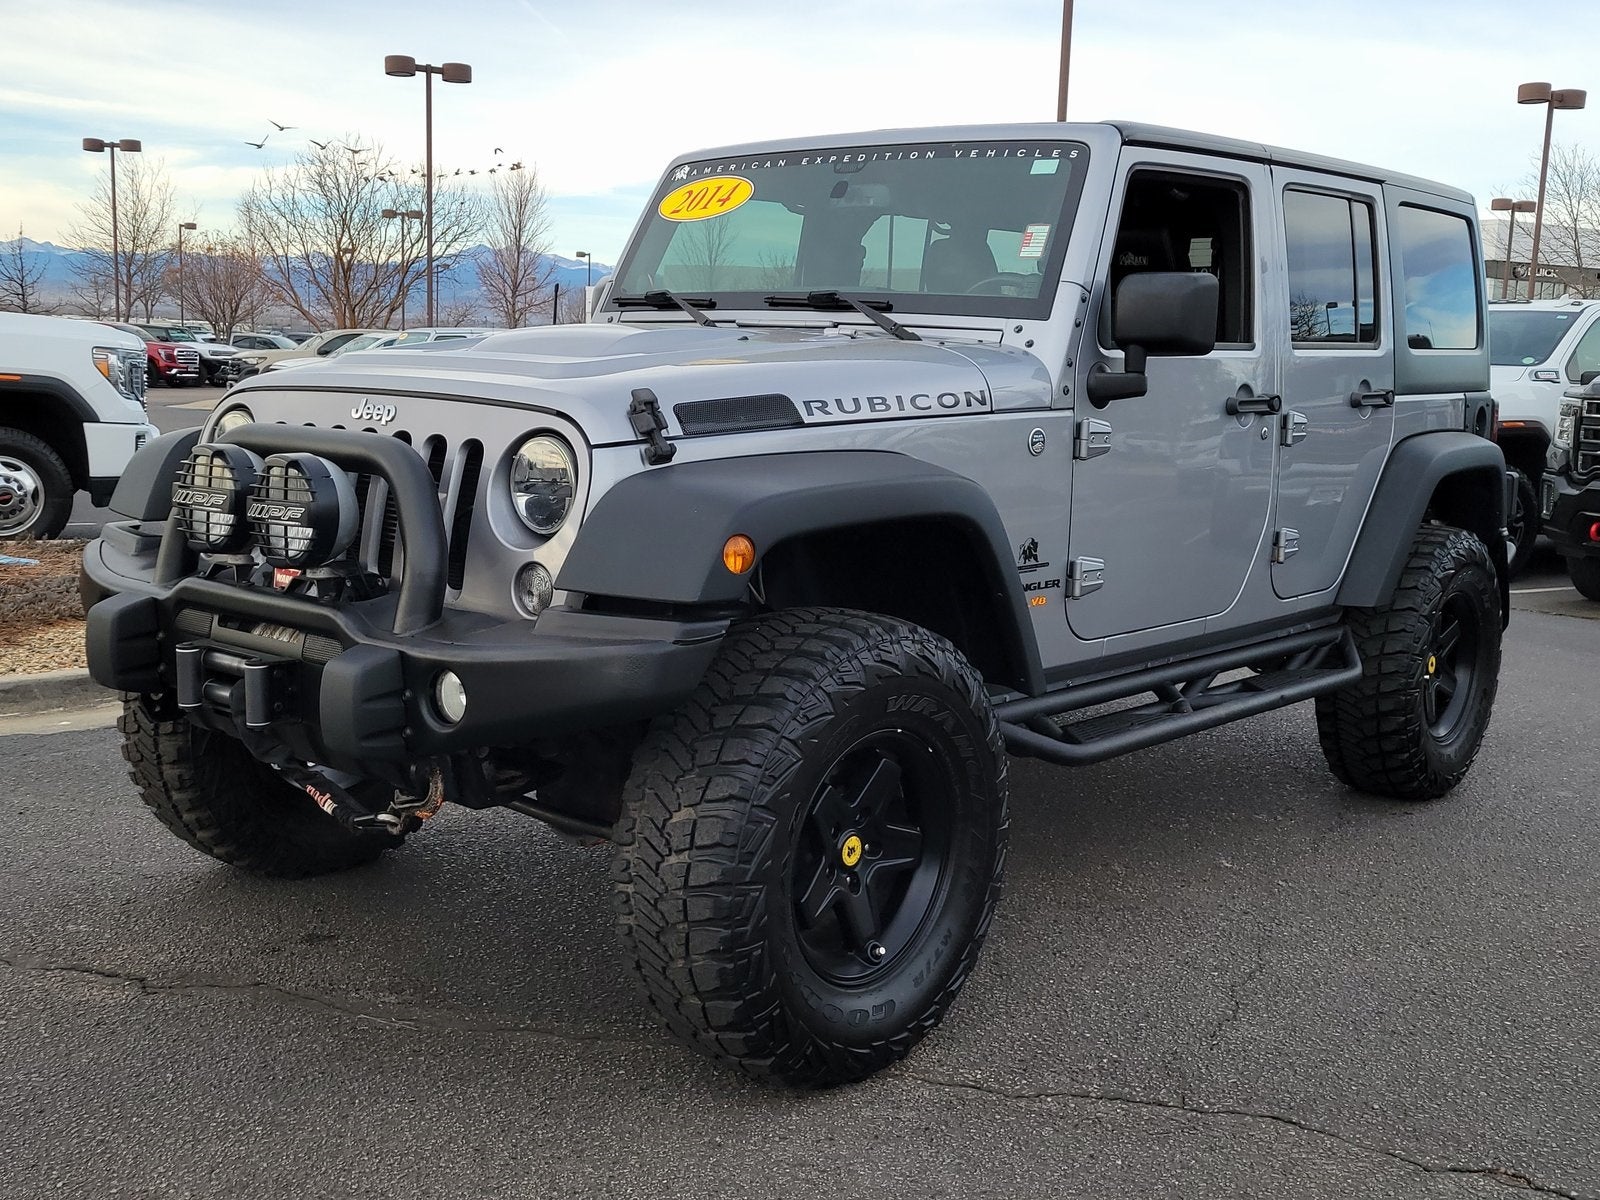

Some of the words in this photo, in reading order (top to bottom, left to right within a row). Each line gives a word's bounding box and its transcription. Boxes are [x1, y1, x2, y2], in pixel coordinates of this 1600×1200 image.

[691, 159, 788, 176] AMERICAN
[801, 150, 936, 166] EXPEDITION
[952, 149, 1081, 159] VEHICLES
[669, 182, 742, 214] 2014
[351, 397, 396, 426] Jeep
[802, 389, 988, 417] RUBICON
[1022, 579, 1061, 592] NGLER
